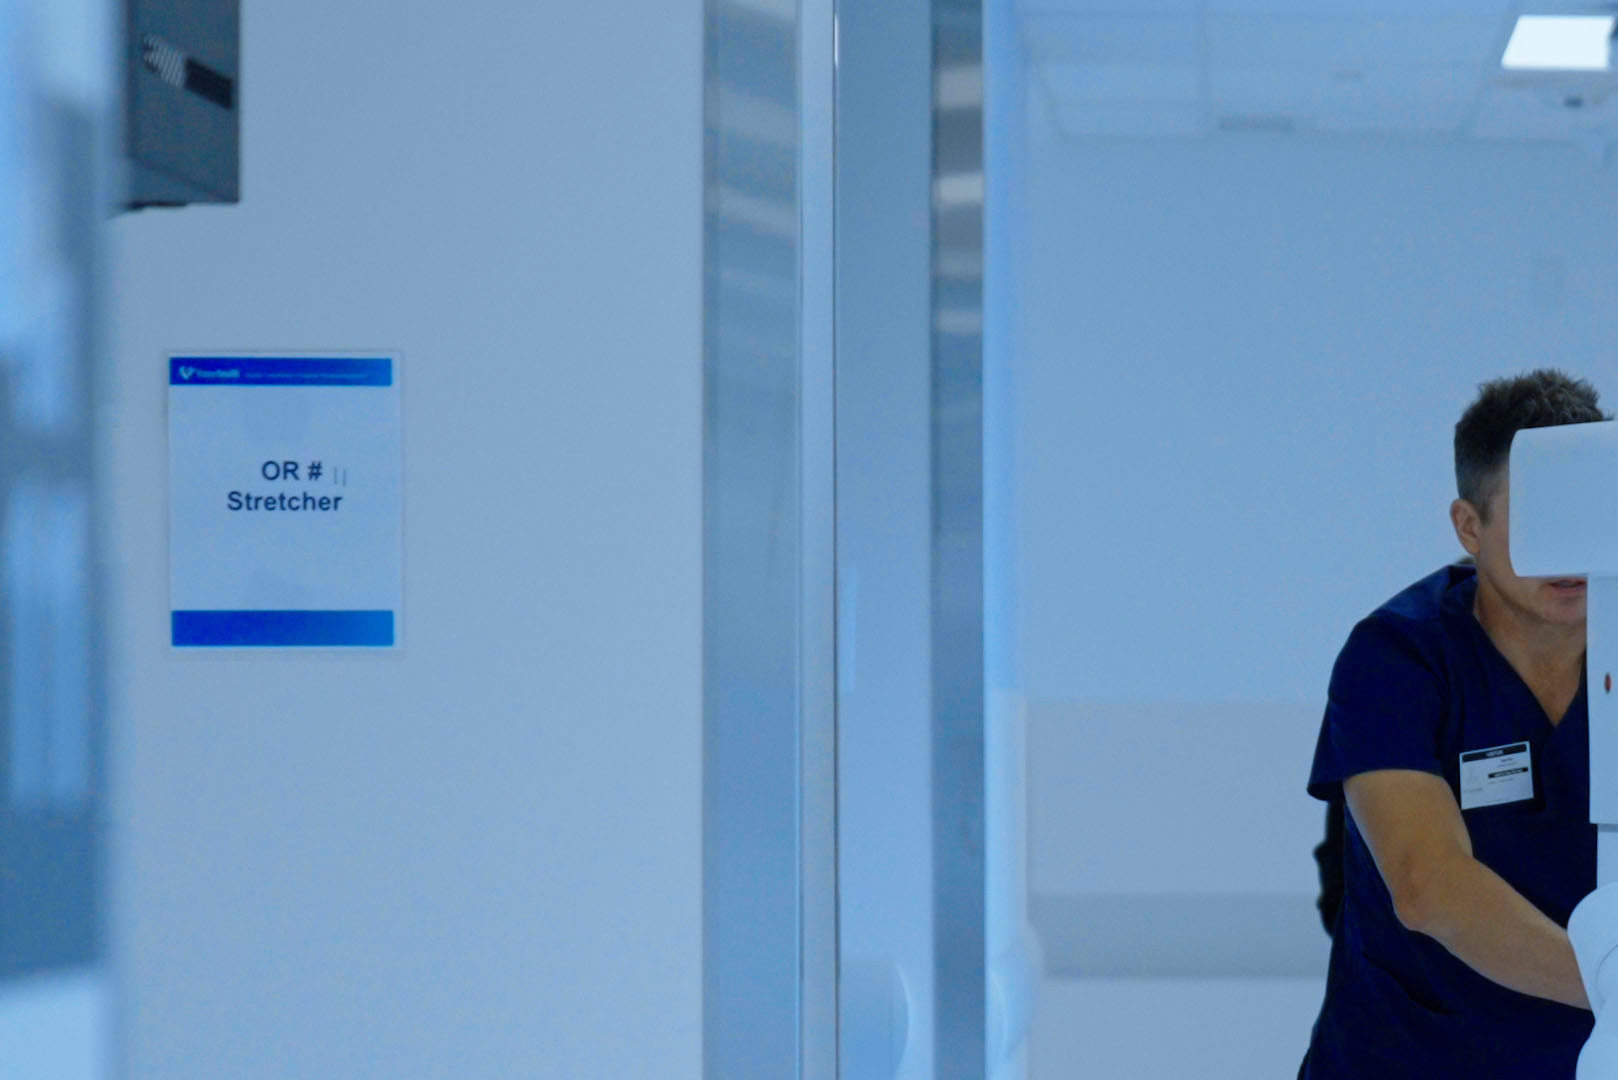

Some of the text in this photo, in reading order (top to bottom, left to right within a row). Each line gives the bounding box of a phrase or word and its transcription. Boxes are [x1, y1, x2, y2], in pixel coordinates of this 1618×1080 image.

[261, 460, 300, 482] OR
[307, 461, 323, 481] #
[227, 490, 343, 512] Stretcher
